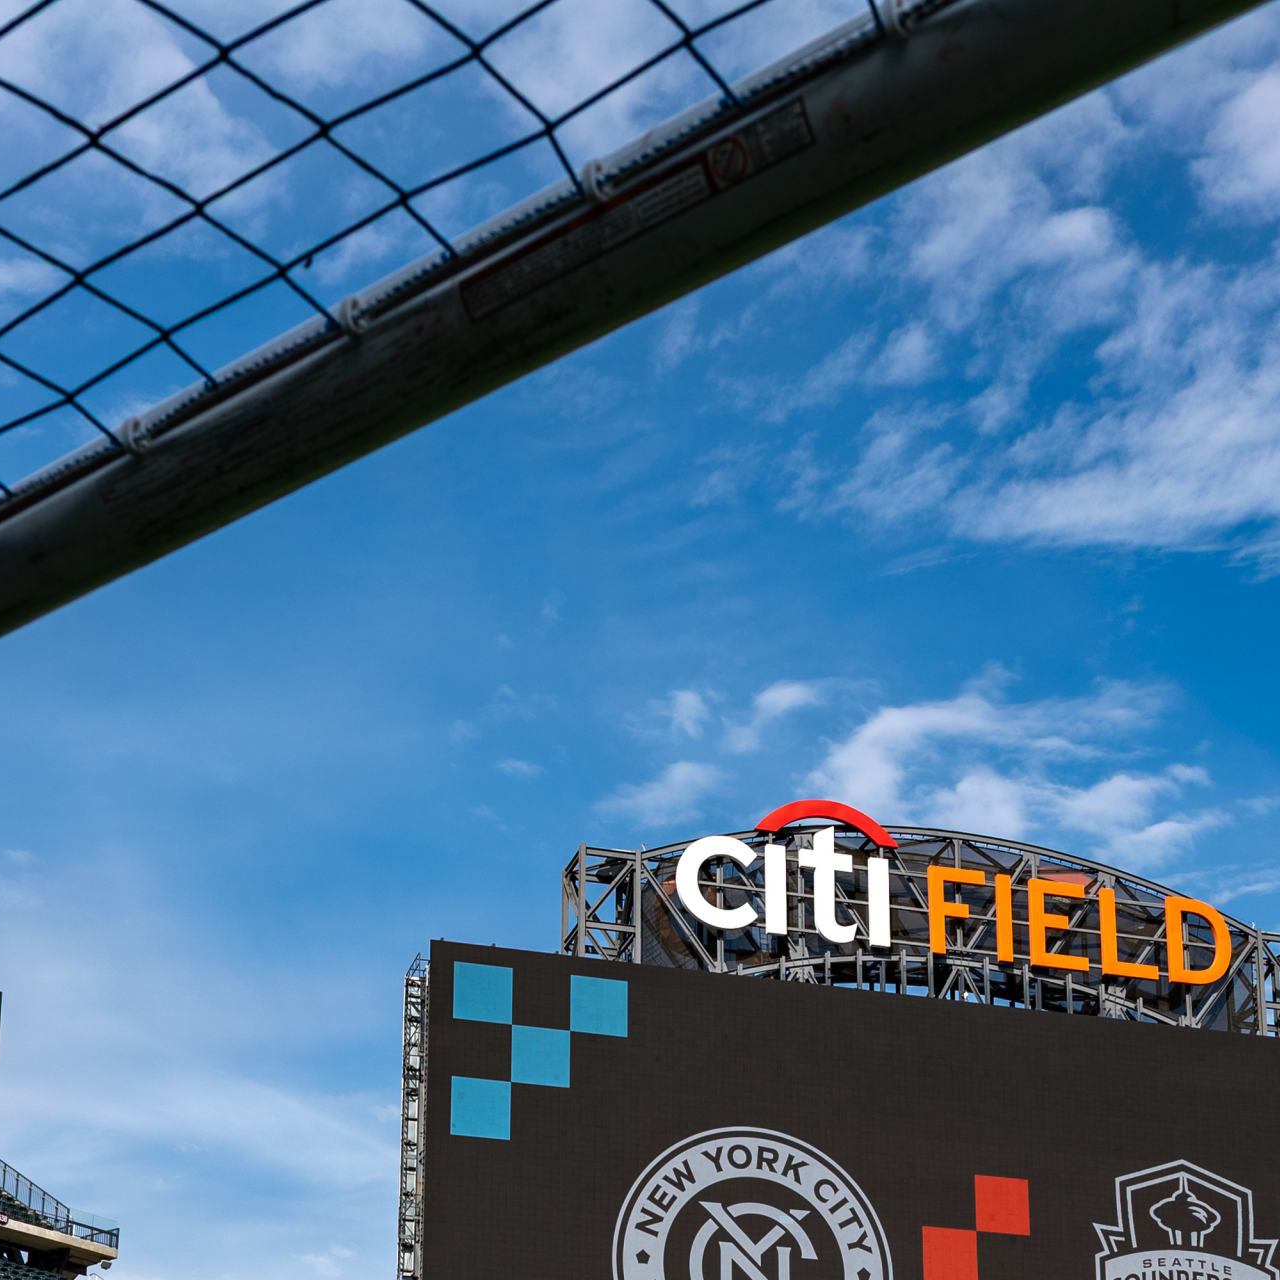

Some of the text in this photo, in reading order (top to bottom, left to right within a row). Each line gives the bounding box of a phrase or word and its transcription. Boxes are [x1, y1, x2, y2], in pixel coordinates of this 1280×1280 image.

[675, 824, 1232, 985] citi FIELD
[634, 1144, 873, 1255] NEW YORK CITY
[1143, 1257, 1232, 1276] SEATTLE
